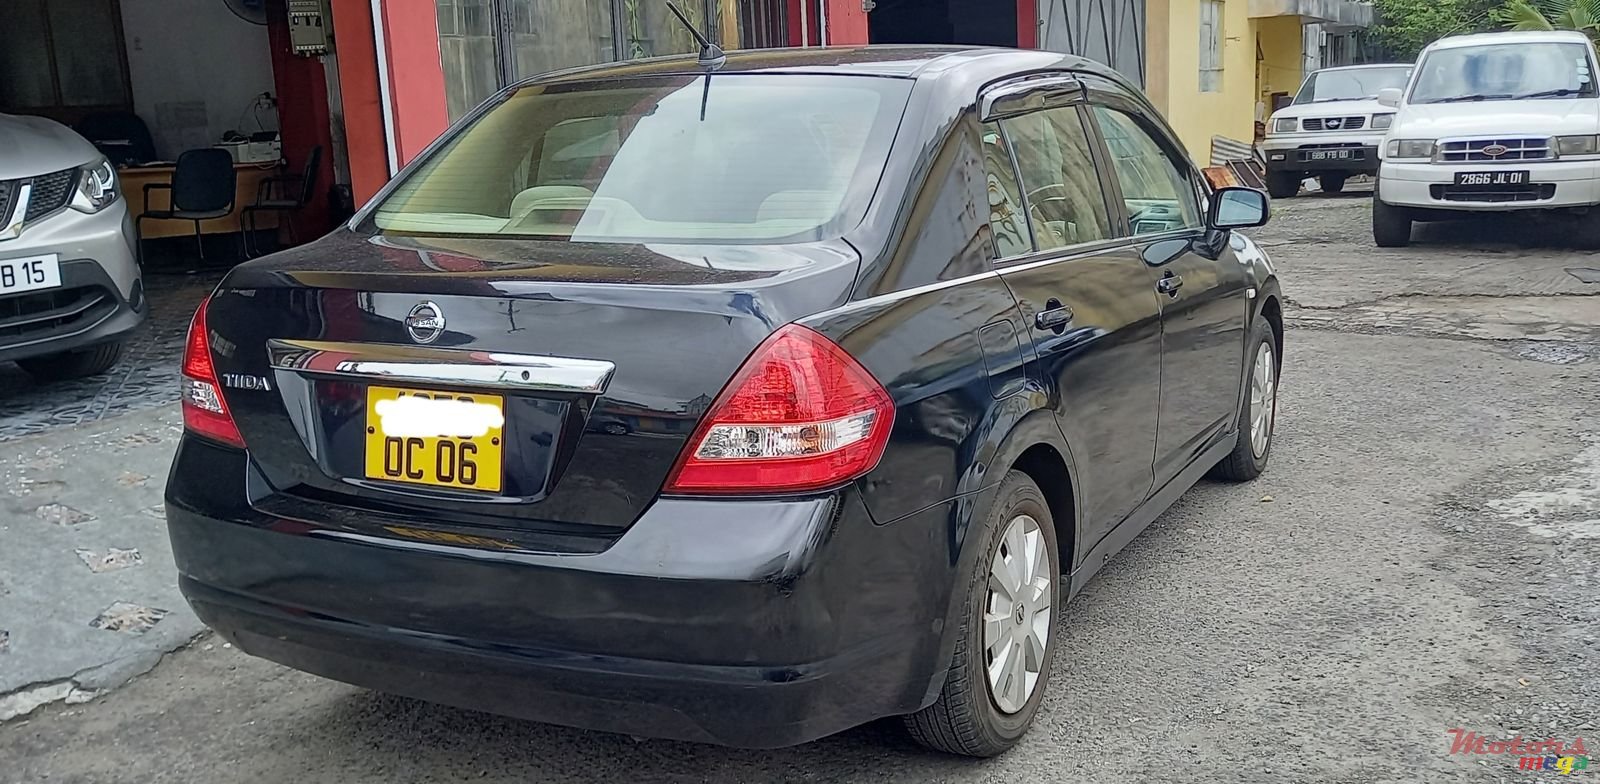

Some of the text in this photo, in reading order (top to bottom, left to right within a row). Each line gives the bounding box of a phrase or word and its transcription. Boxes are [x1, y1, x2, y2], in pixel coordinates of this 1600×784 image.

[1460, 172, 1523, 185] 2866 JL 01
[1, 260, 45, 288] B 15
[384, 435, 477, 486] OC 06
